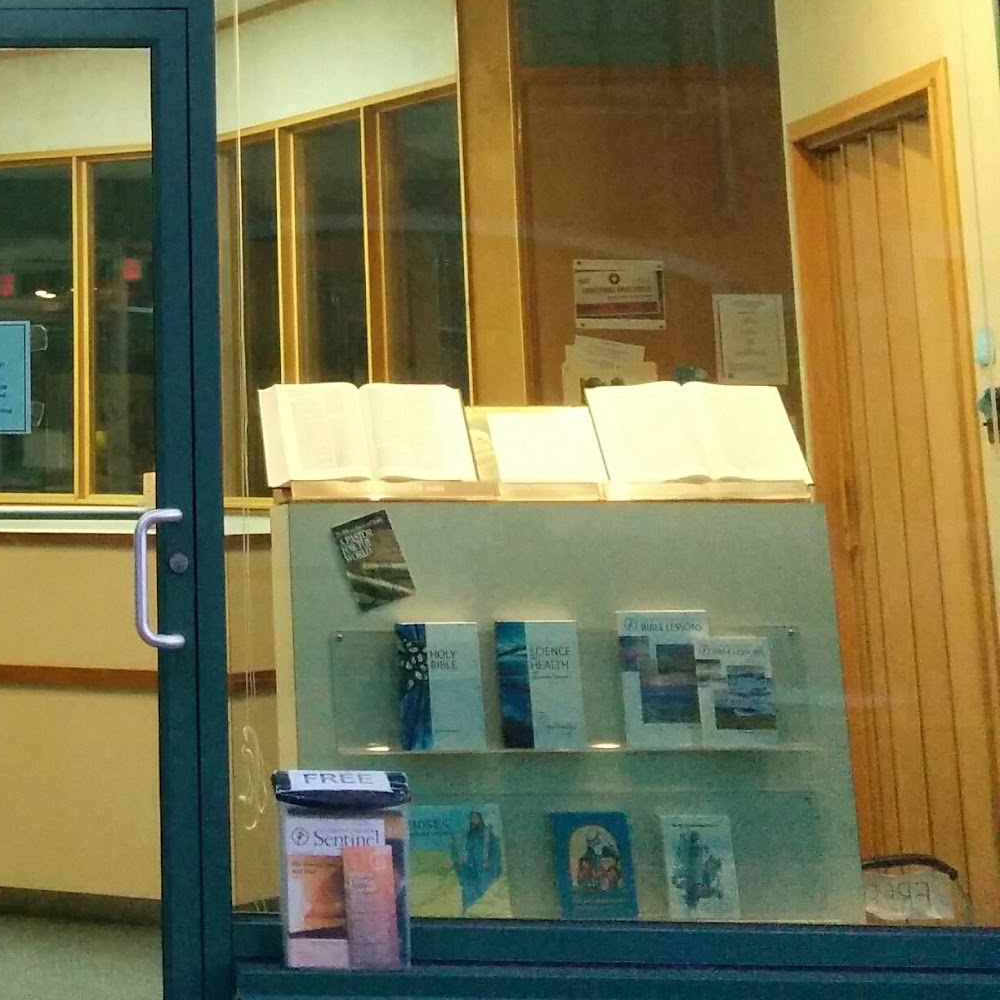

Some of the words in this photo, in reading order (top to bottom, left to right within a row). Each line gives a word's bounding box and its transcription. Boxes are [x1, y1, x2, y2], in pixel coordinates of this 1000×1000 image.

[641, 622, 662, 632] BIBLE
[665, 622, 702, 632] LESSONS
[429, 650, 457, 659] HOLY
[430, 660, 457, 670] BIBLE
[531, 660, 569, 670] HEALTH
[303, 773, 375, 785] FREE
[313, 830, 380, 847] Sentinel
